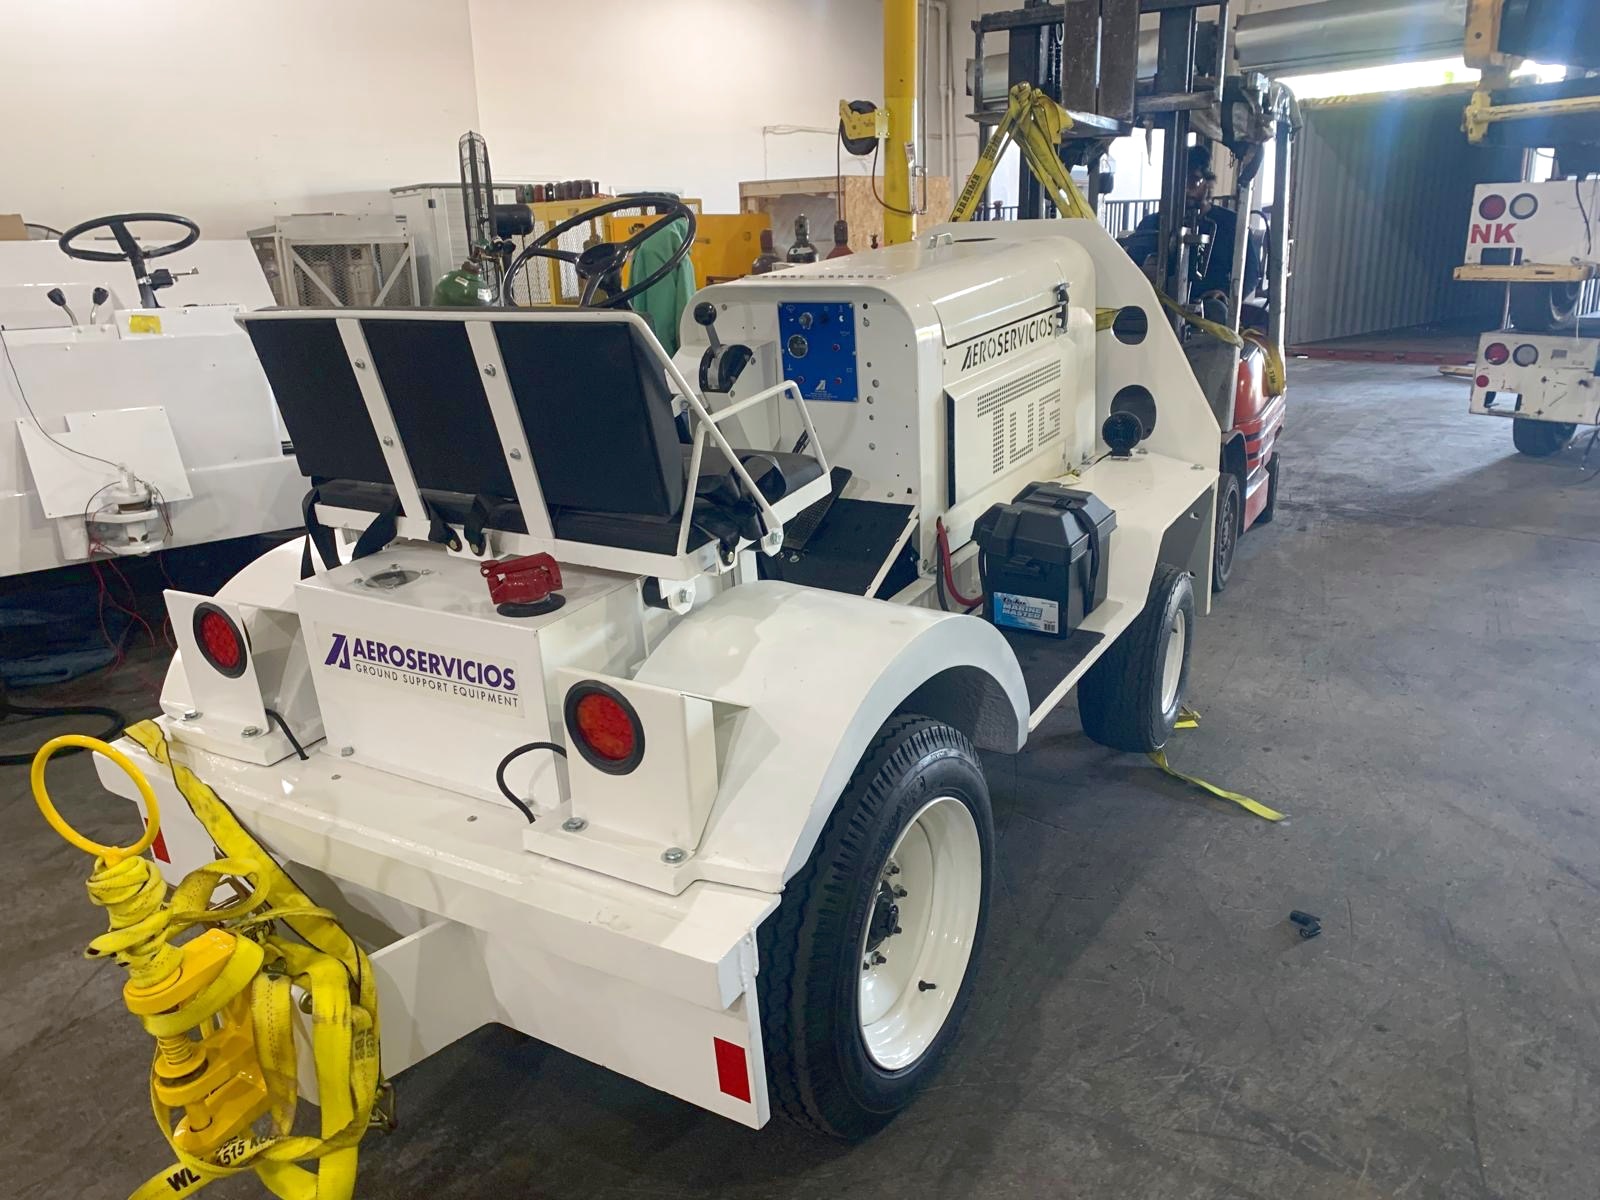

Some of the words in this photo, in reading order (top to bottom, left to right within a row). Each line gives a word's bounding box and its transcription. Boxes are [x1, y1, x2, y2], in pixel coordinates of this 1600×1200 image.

[1470, 223, 1517, 244] NK
[961, 314, 1053, 372] AEROSERVICIOS
[353, 637, 516, 691] AEROSERVICIOS
[355, 663, 398, 681] GROUND
[403, 673, 448, 693] SUPPORT
[453, 685, 519, 708] EQUIPMENT
